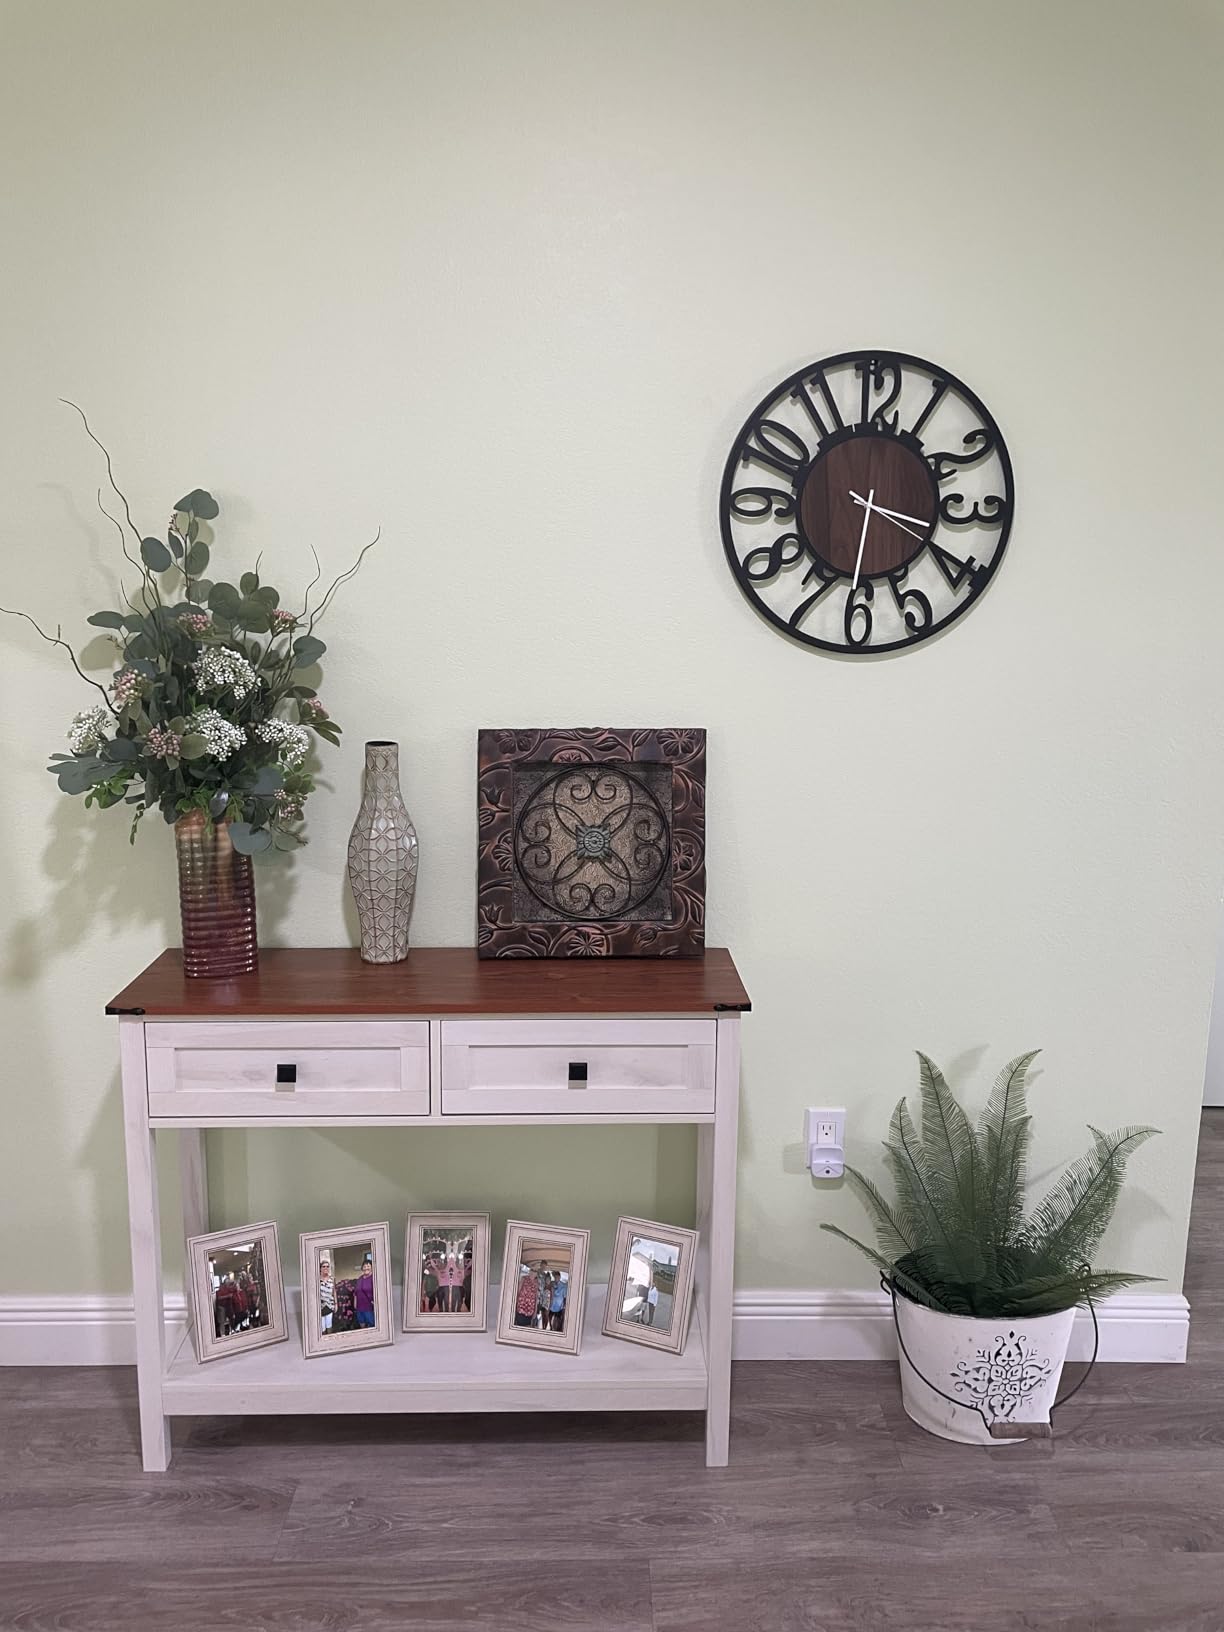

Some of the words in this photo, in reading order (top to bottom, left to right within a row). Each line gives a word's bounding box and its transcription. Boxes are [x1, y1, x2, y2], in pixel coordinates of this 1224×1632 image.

[790, 368, 853, 451] 11
[855, 359, 901, 433] 12
[899, 378, 951, 449] 1
[742, 419, 810, 488] 10
[925, 428, 995, 481] 2
[730, 486, 797, 517] 9
[940, 493, 1006, 524] 3
[742, 532, 802, 581] 8
[926, 540, 988, 593] 4
[789, 560, 839, 628] 7
[845, 583, 874, 646] 6
[888, 561, 933, 634] 5
